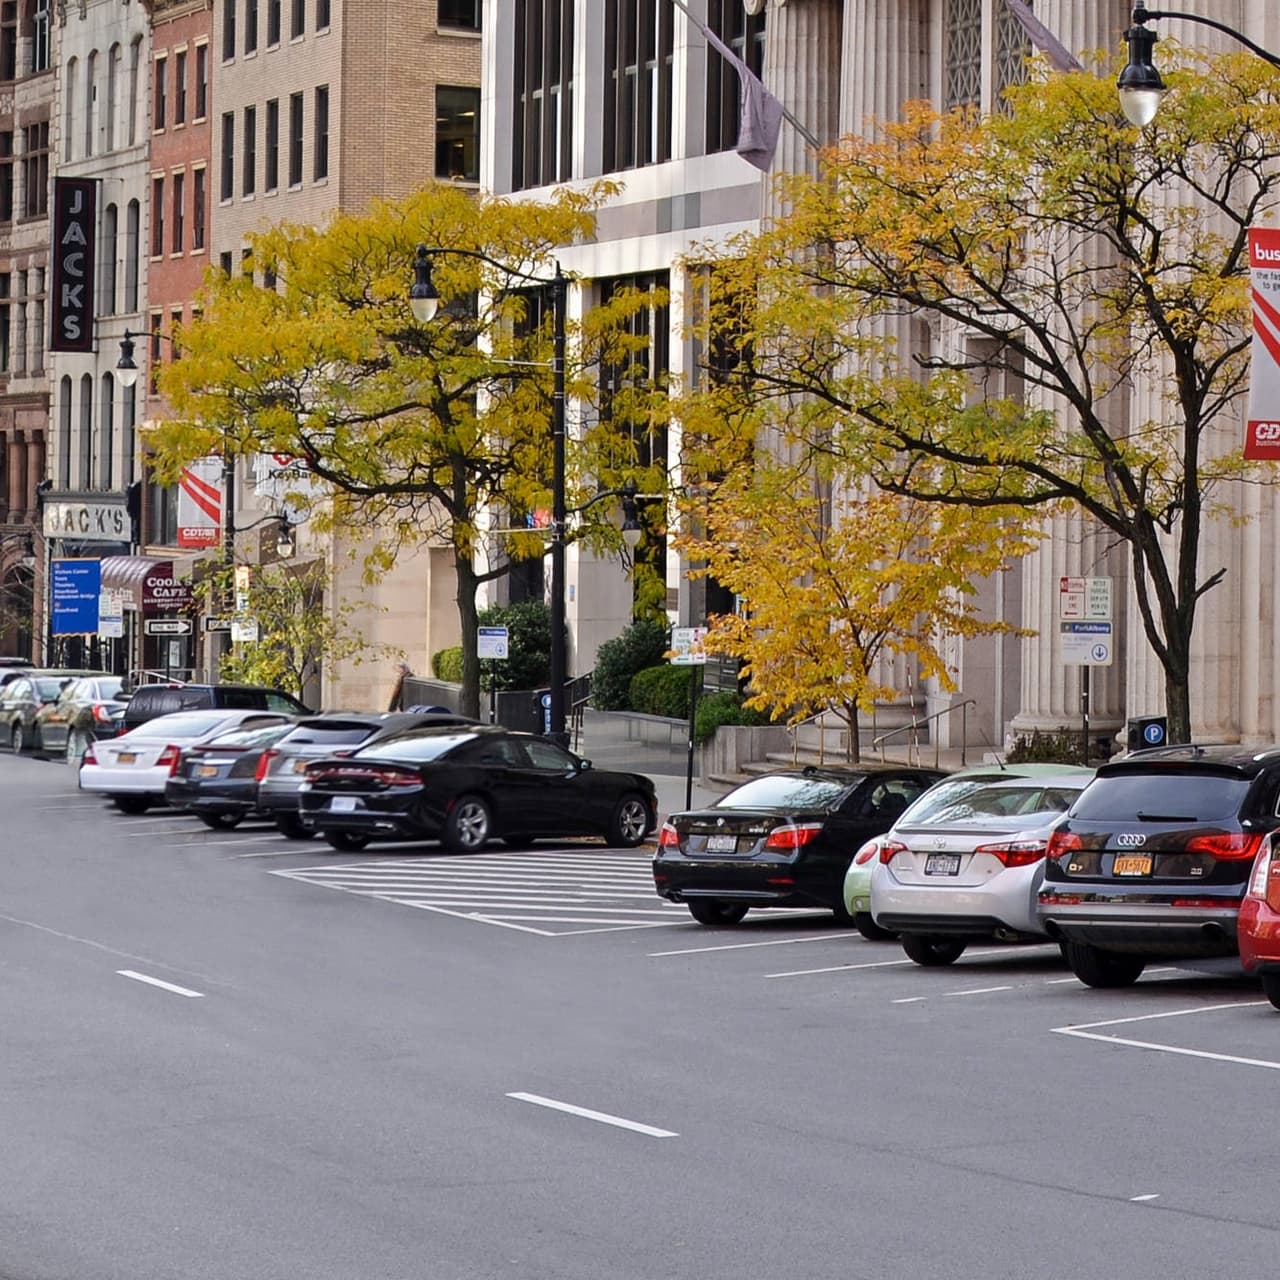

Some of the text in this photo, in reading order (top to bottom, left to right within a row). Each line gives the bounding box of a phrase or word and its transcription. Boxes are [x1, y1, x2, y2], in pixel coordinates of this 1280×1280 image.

[61, 189, 87, 340] JACKS
[1256, 271, 1268, 280] the
[1262, 281, 1270, 289] to
[268, 469, 318, 481] KeyBa
[49, 506, 123, 535] JACK'S
[152, 587, 187, 597] CAFE
[1150, 727, 1159, 741] P
